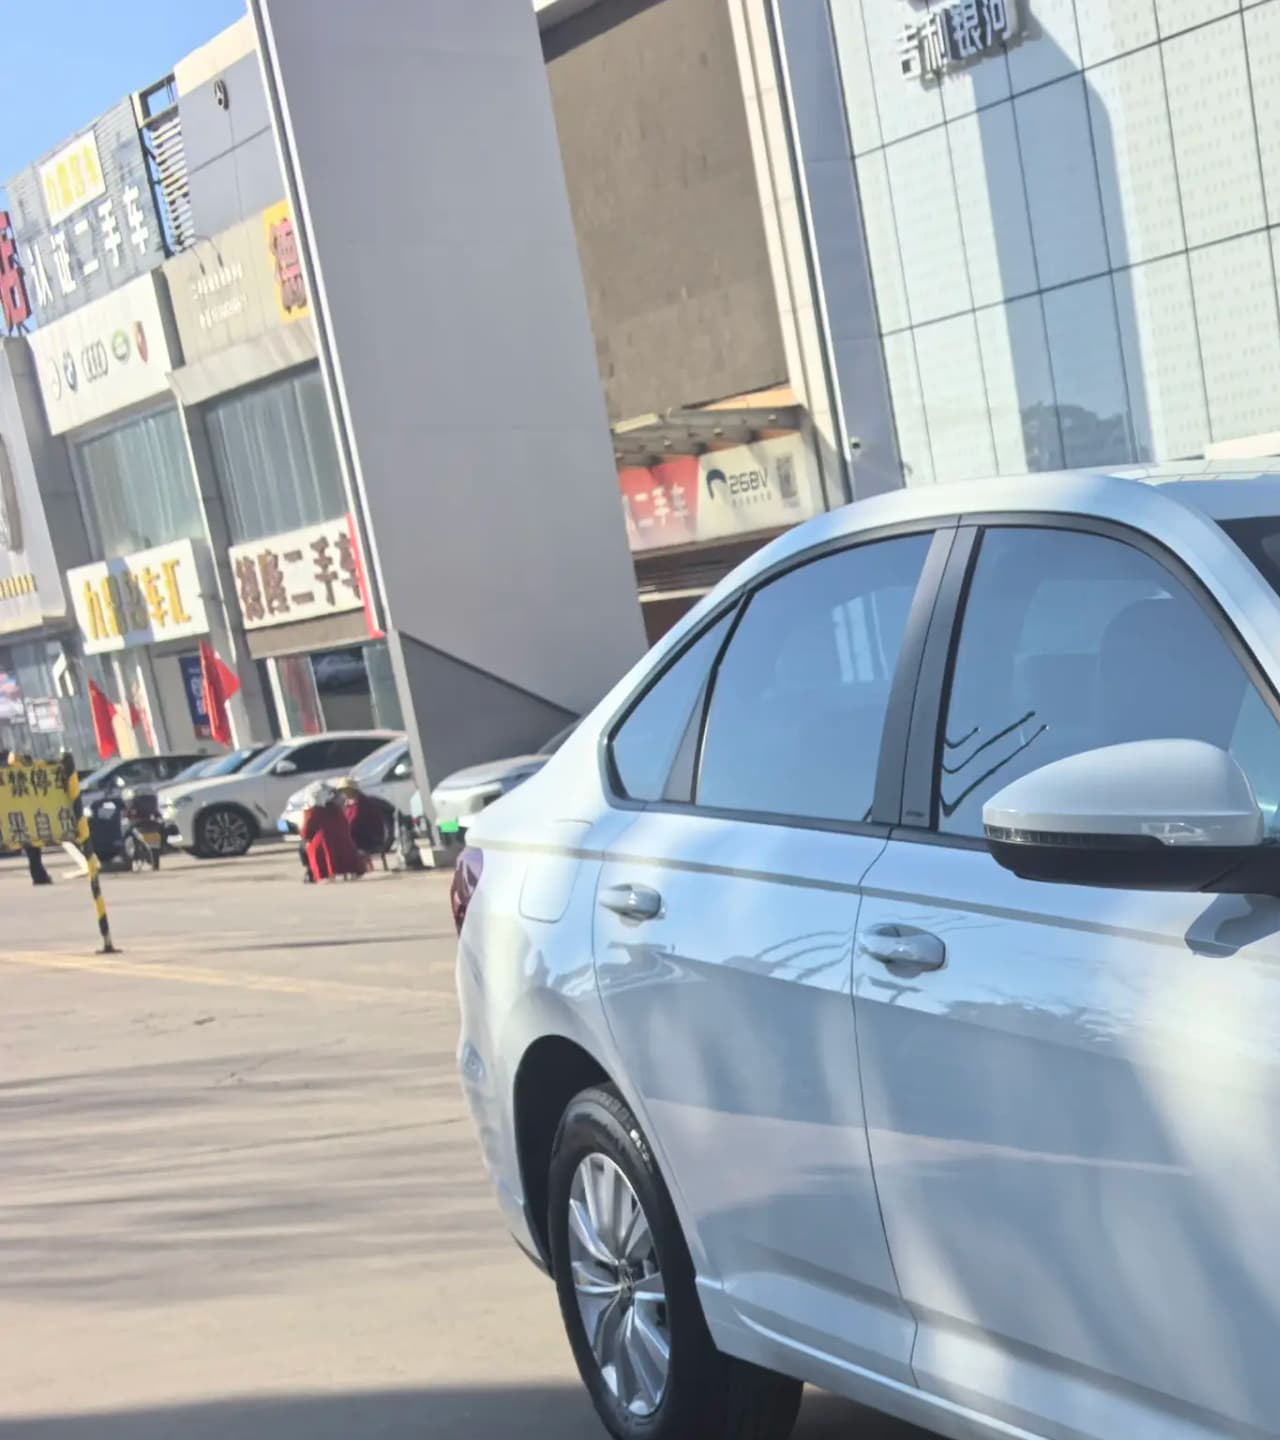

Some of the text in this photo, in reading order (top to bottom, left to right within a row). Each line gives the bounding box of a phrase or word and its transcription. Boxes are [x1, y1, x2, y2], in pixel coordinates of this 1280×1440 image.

[27, 185, 149, 309] 认证二手车
